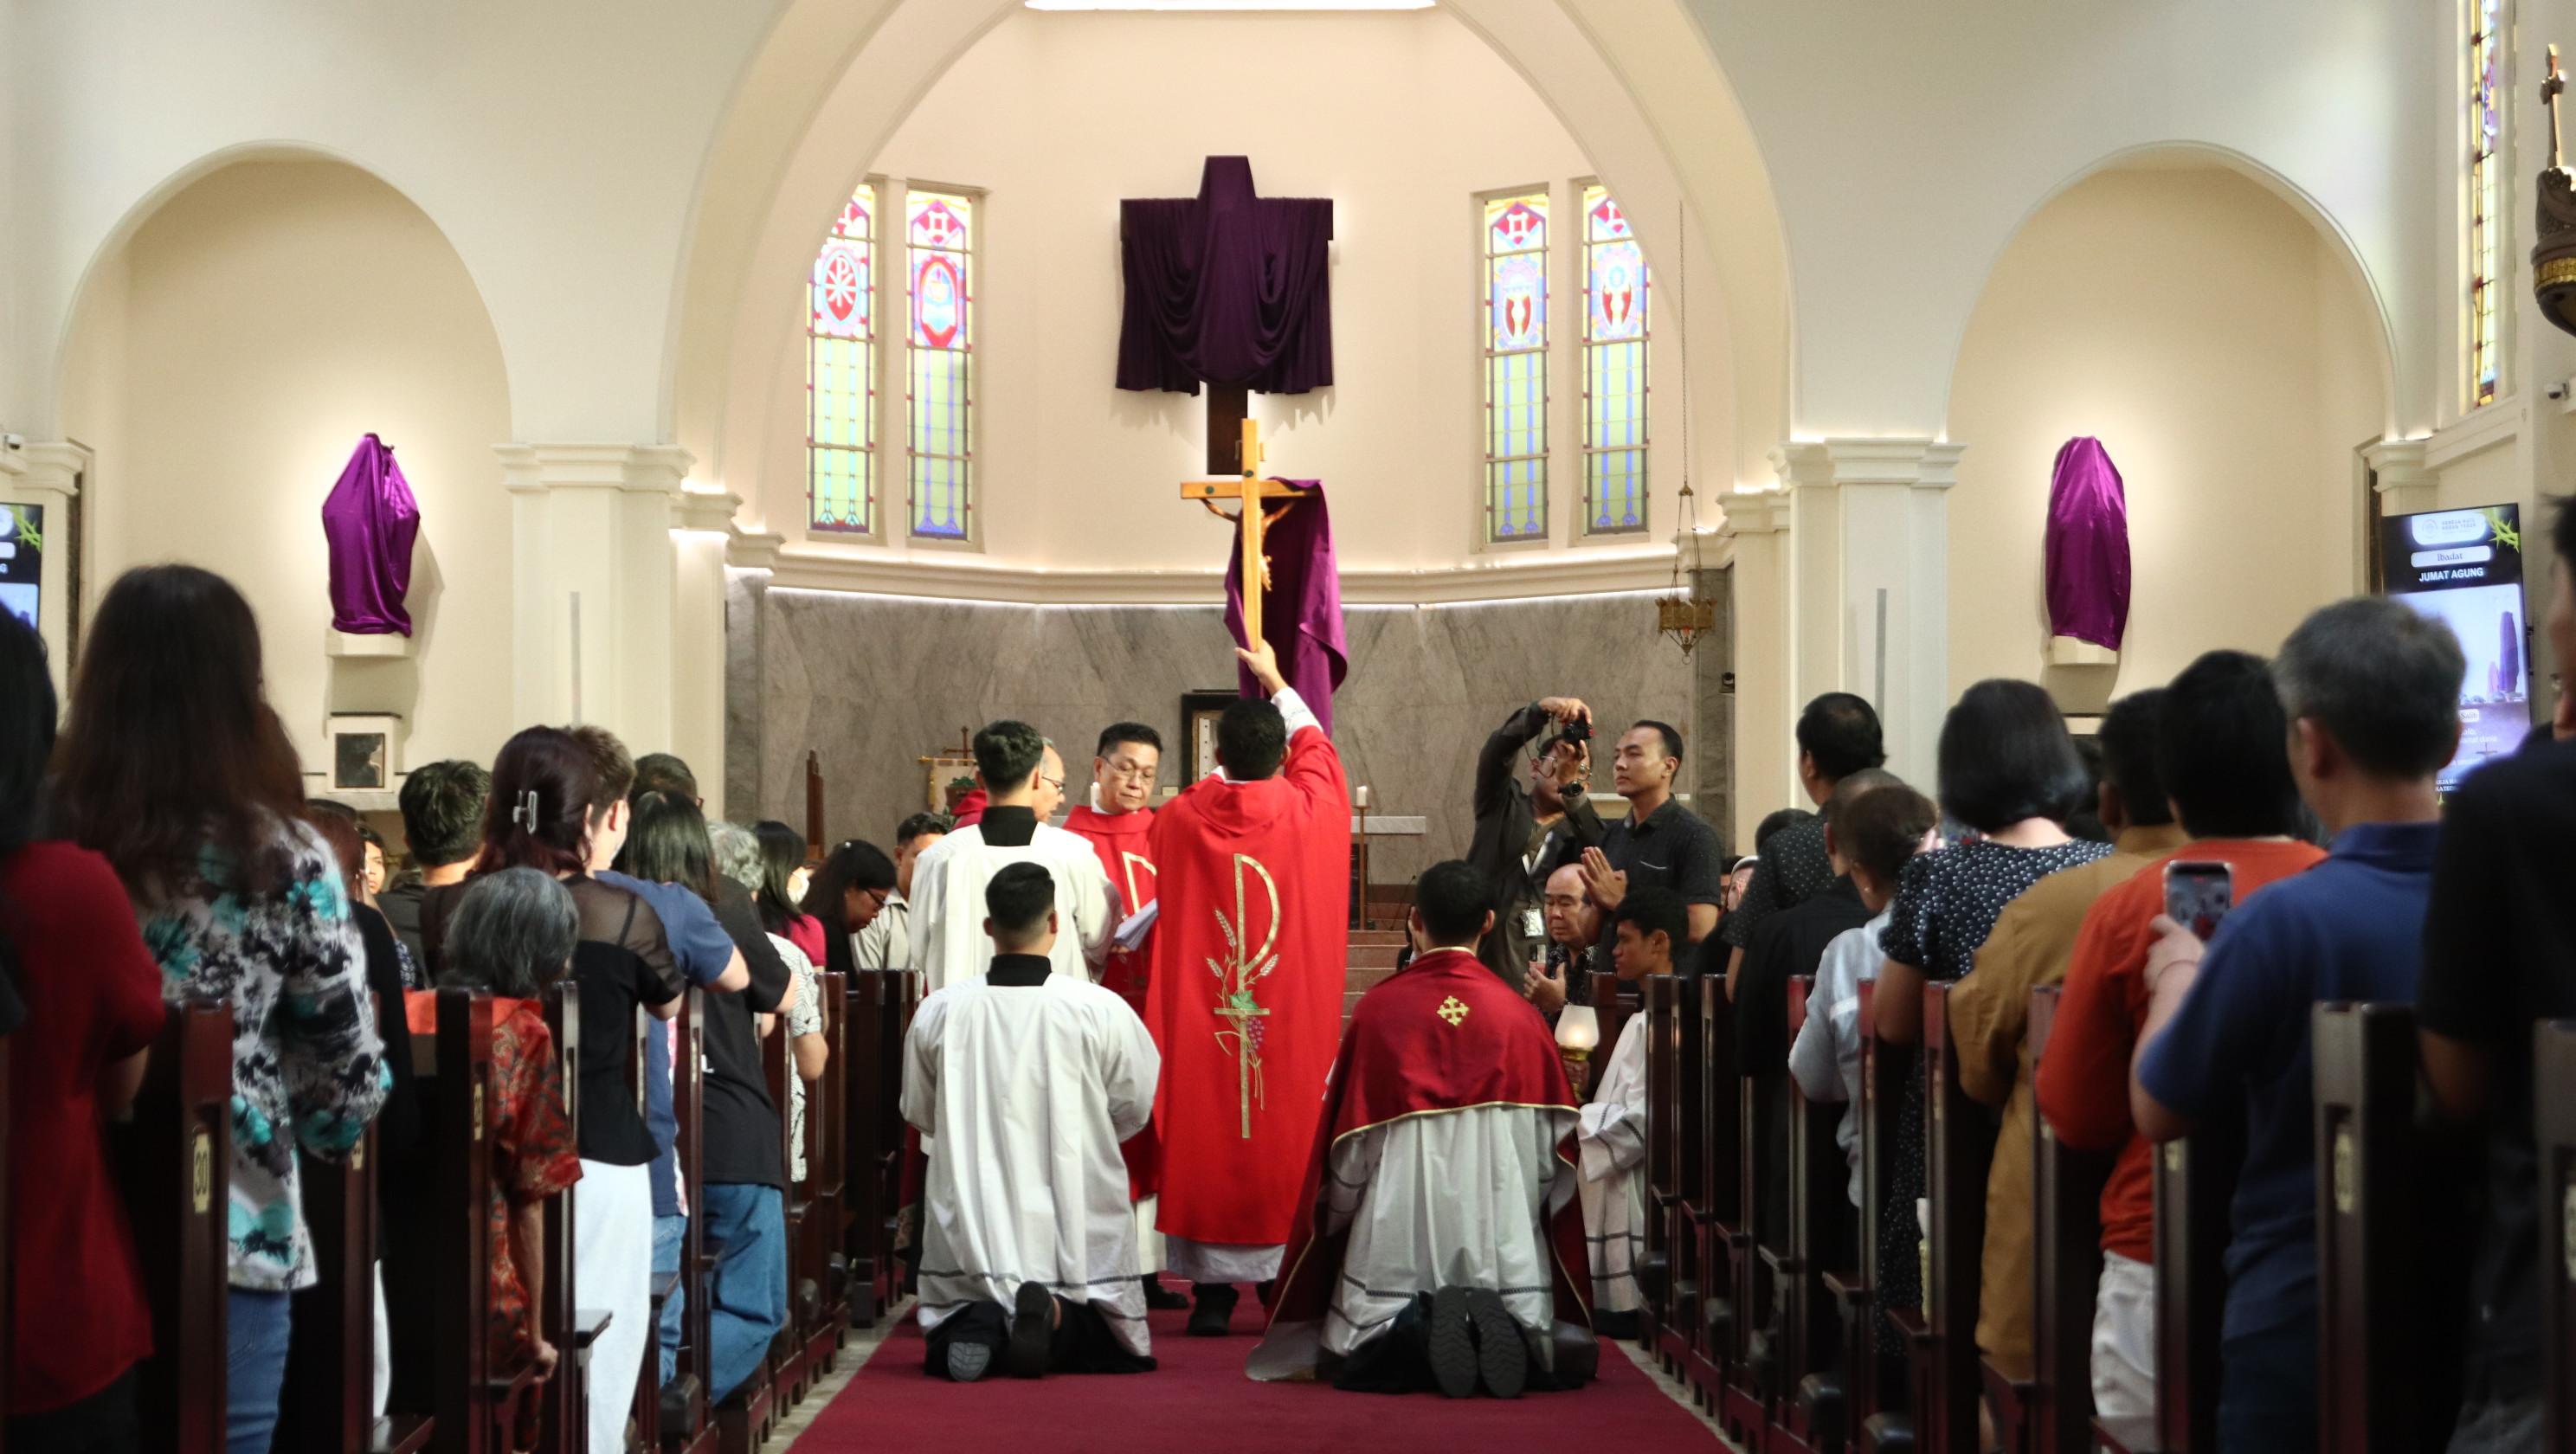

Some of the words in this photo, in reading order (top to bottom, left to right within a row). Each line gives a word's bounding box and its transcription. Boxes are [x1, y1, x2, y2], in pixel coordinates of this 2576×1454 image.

[2419, 570, 2449, 582] JUMAT
[2451, 567, 2483, 579] AGUNG
[196, 1151, 208, 1195] 30
